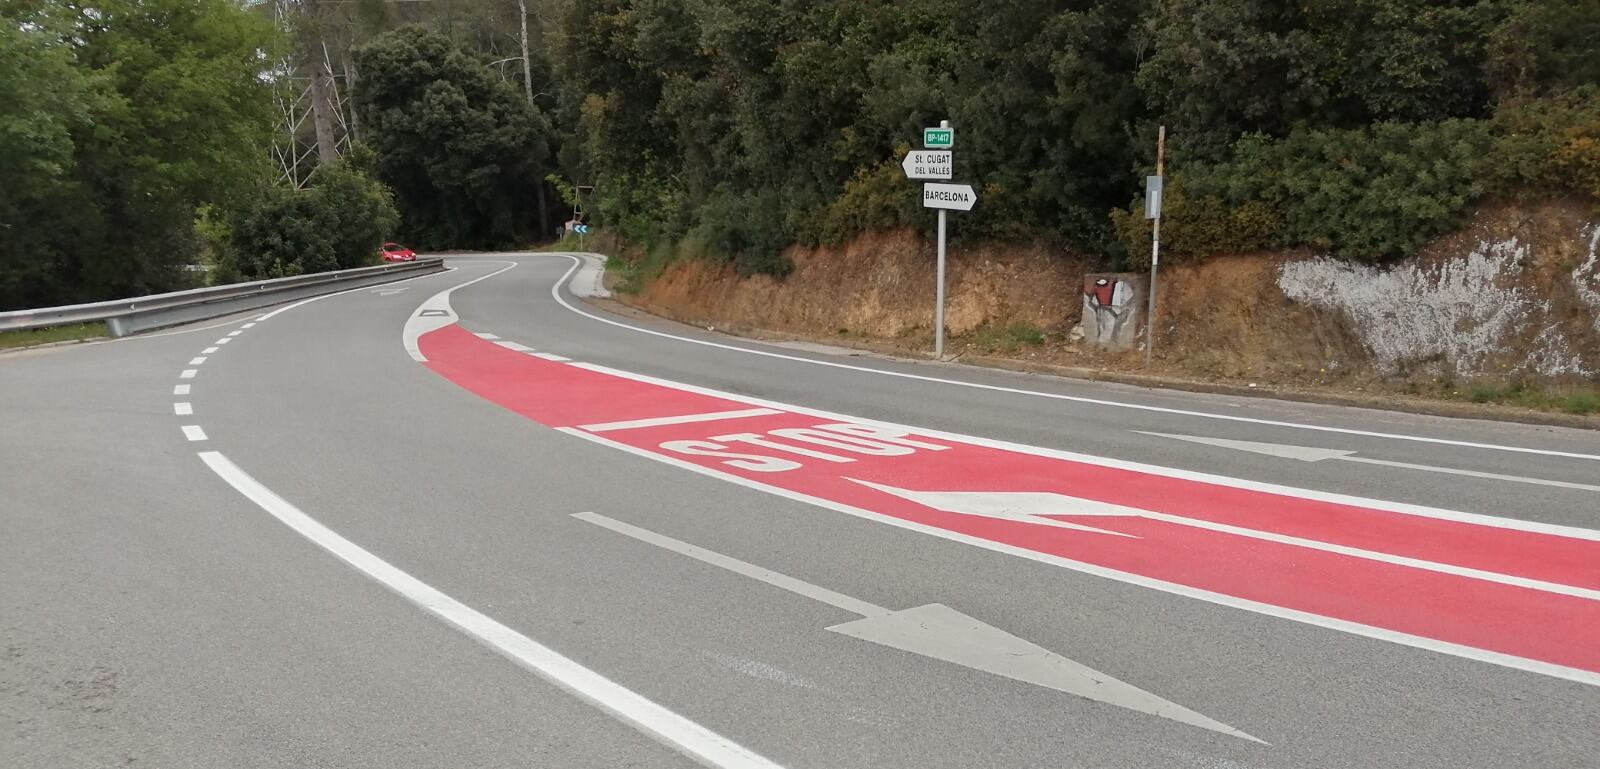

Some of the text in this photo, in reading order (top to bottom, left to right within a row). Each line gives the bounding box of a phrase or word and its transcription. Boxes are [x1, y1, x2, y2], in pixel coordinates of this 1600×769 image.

[928, 134, 949, 142] BP-1417
[927, 155, 949, 163] CUGAT
[925, 191, 969, 202] BARCELONA
[659, 423, 953, 472] STOP
